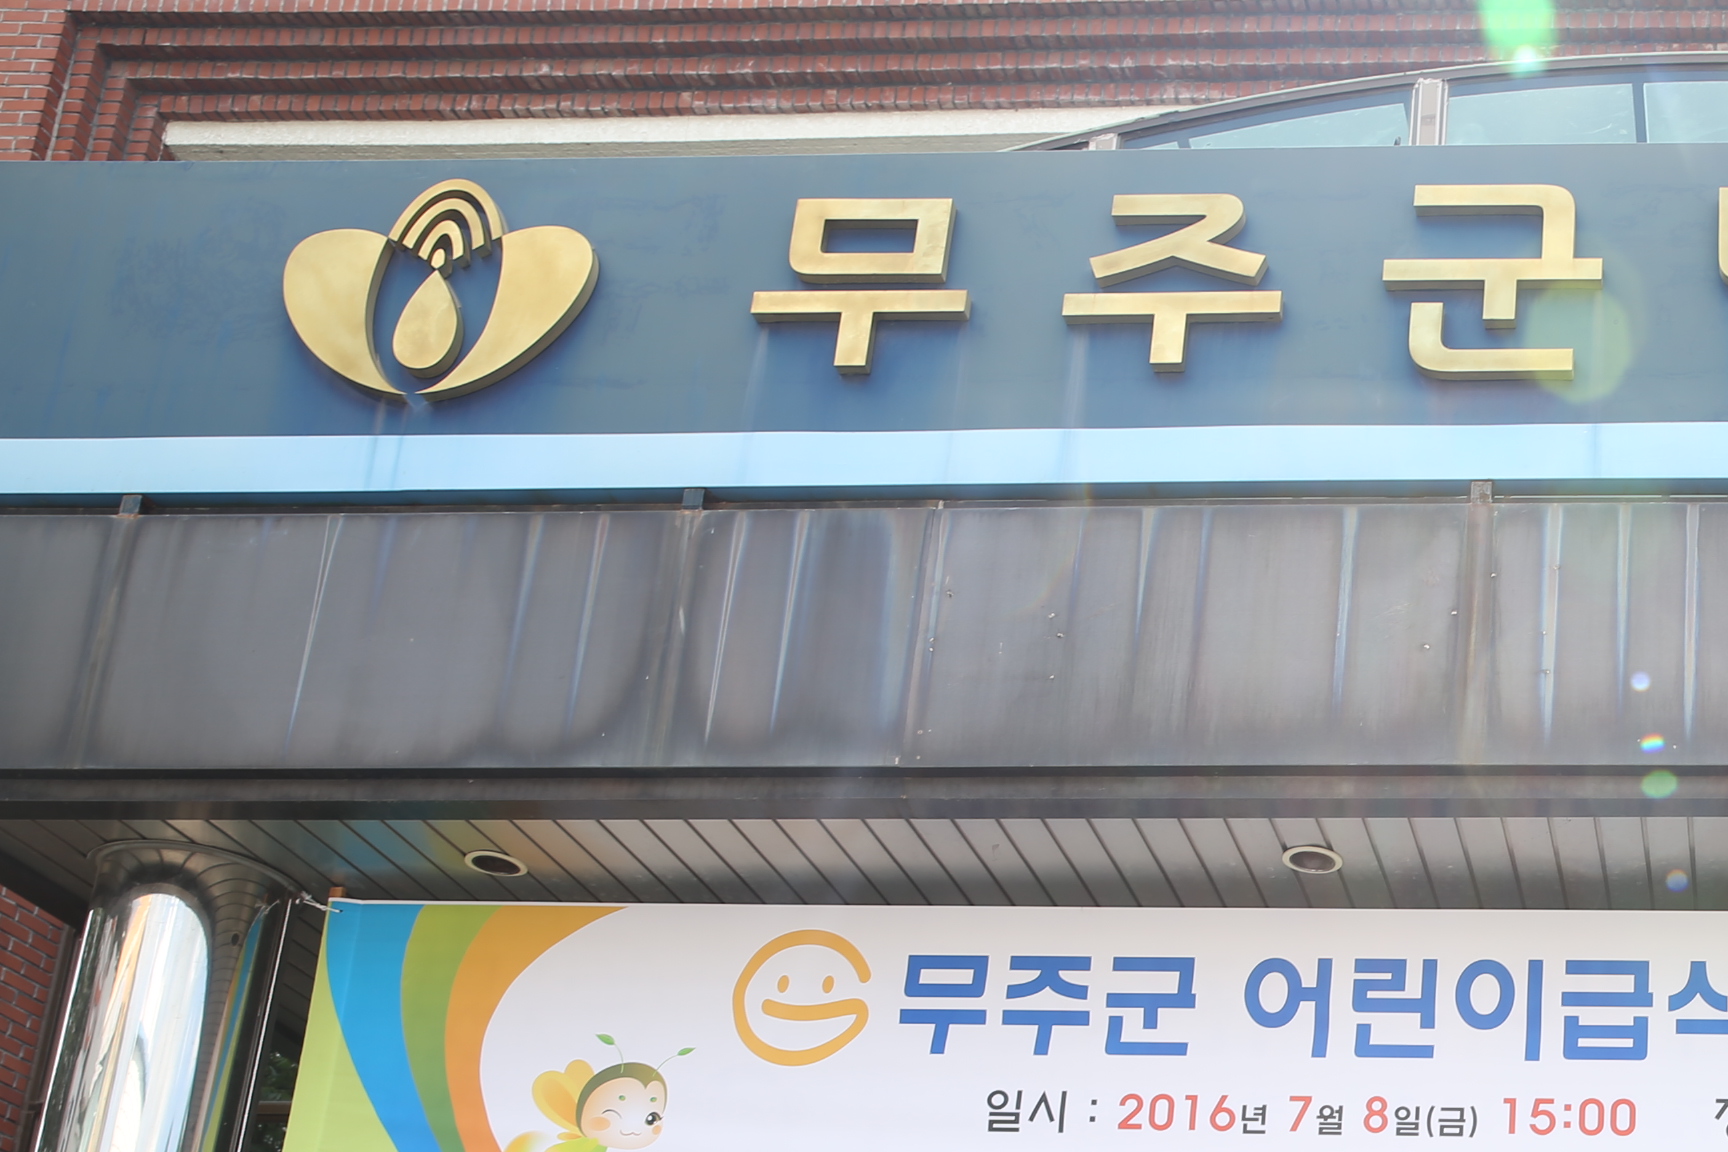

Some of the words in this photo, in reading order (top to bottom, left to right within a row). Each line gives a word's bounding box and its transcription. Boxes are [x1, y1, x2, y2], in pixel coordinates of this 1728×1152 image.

[898, 953, 1197, 1057] 무주군
[985, 1089, 1067, 1134] 일시
[1117, 1093, 1269, 1135] 2016년
[1287, 1095, 1345, 1136] 7월
[1362, 1096, 1478, 1139] 8일(금)
[1502, 1097, 1638, 1137] 15:00
